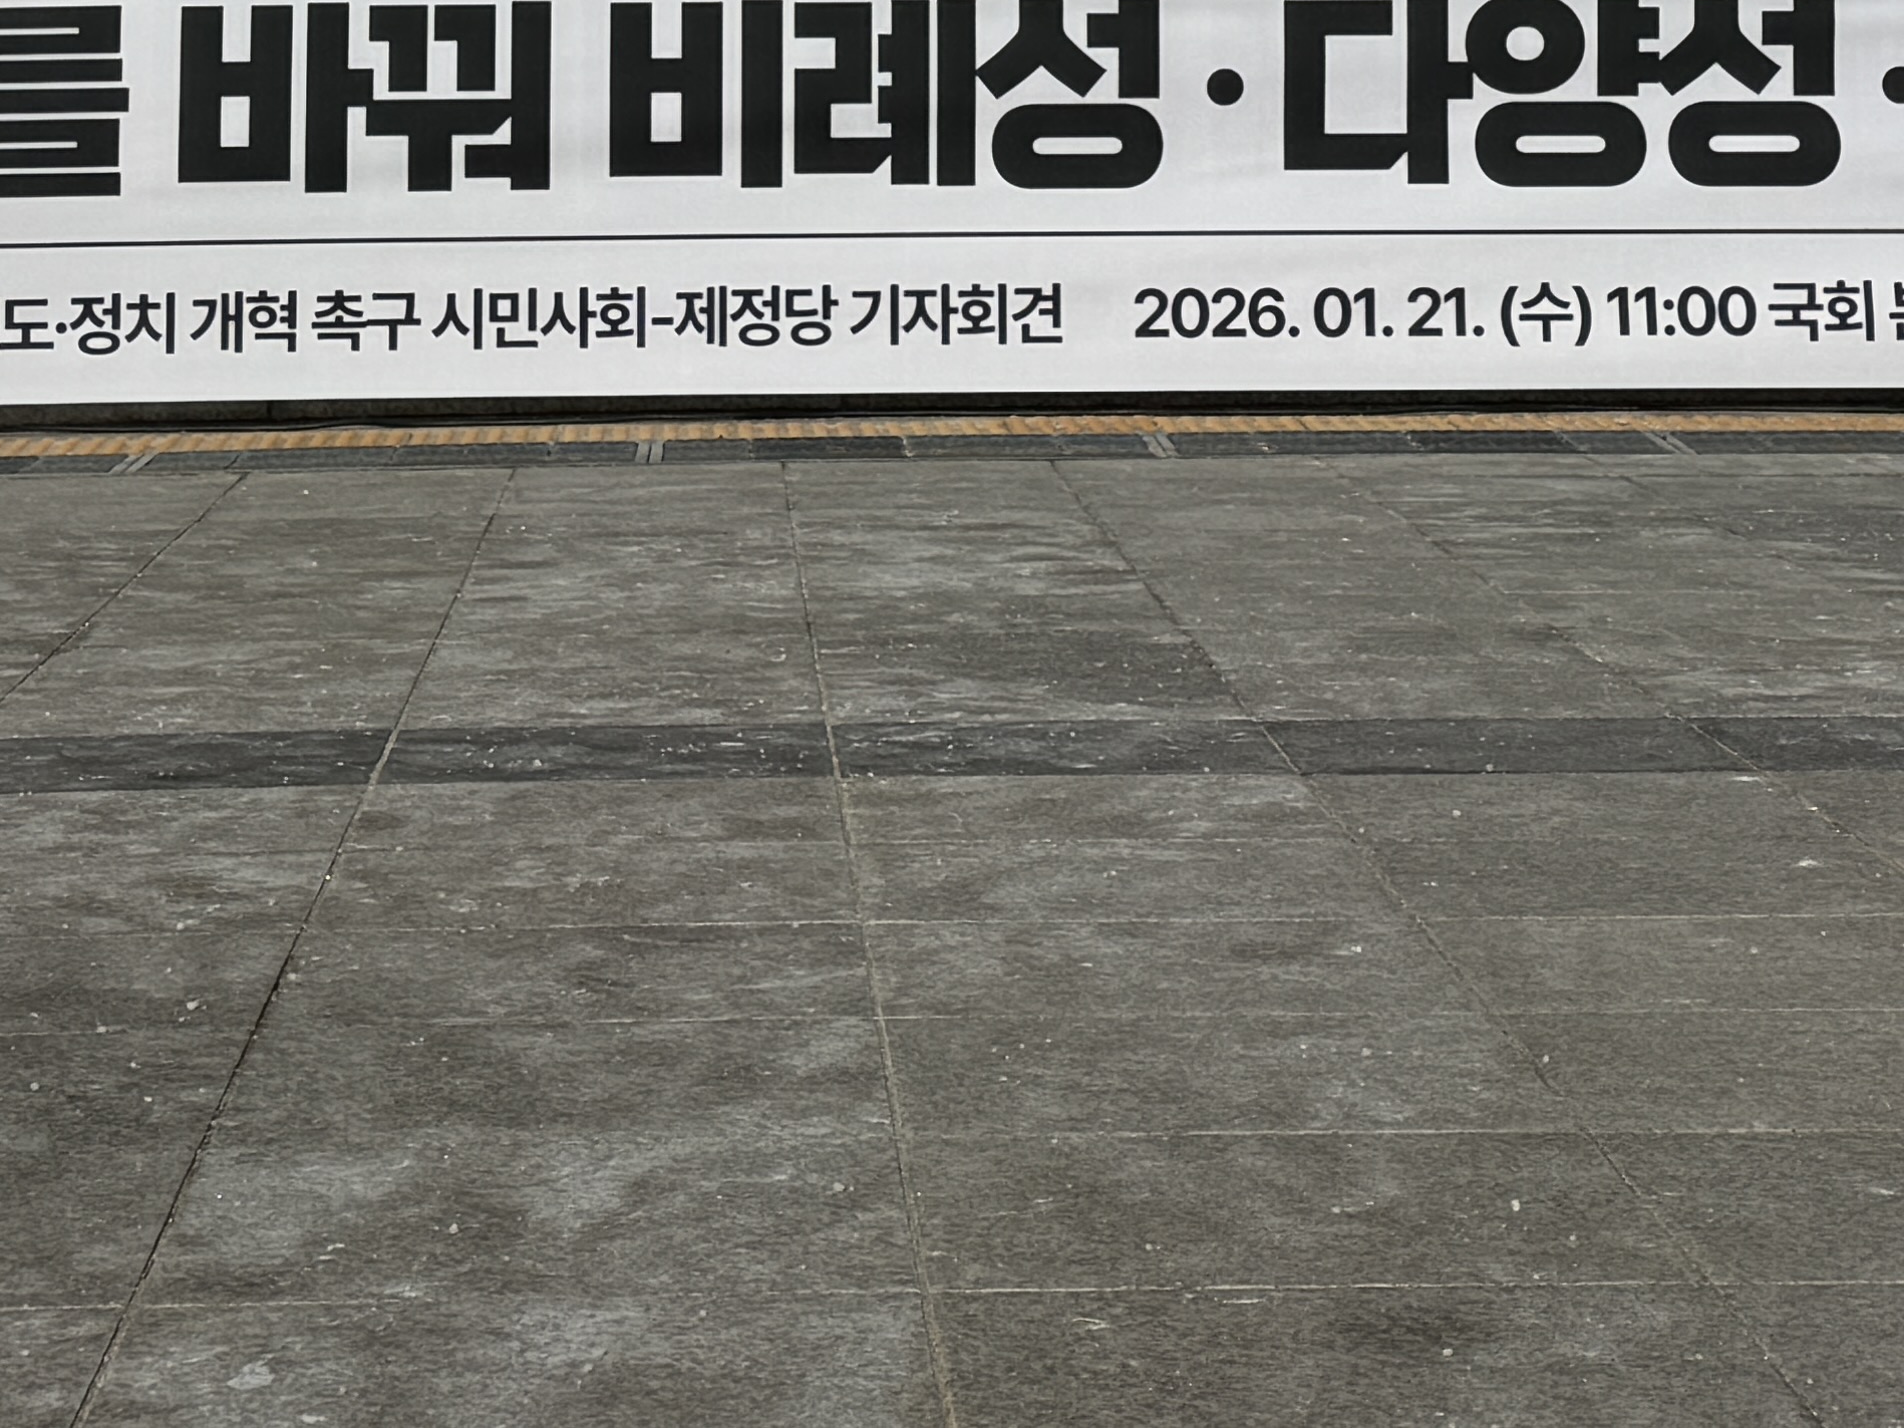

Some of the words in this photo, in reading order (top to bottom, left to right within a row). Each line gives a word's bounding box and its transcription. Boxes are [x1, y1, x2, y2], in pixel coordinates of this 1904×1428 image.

[178, 0, 552, 193] 바꿔
[190, 290, 297, 353] 개혁
[311, 289, 422, 352] 촉구
[431, 284, 839, 350] 시민사회-제정당
[850, 282, 1063, 346] 기자회견
[1134, 287, 1300, 339] 2026.
[1313, 287, 1394, 338] 01.
[1407, 286, 1485, 337] 21.
[1500, 282, 1592, 347] (수)
[1606, 285, 1757, 337] 11:00
[1768, 279, 1875, 342] 국회
